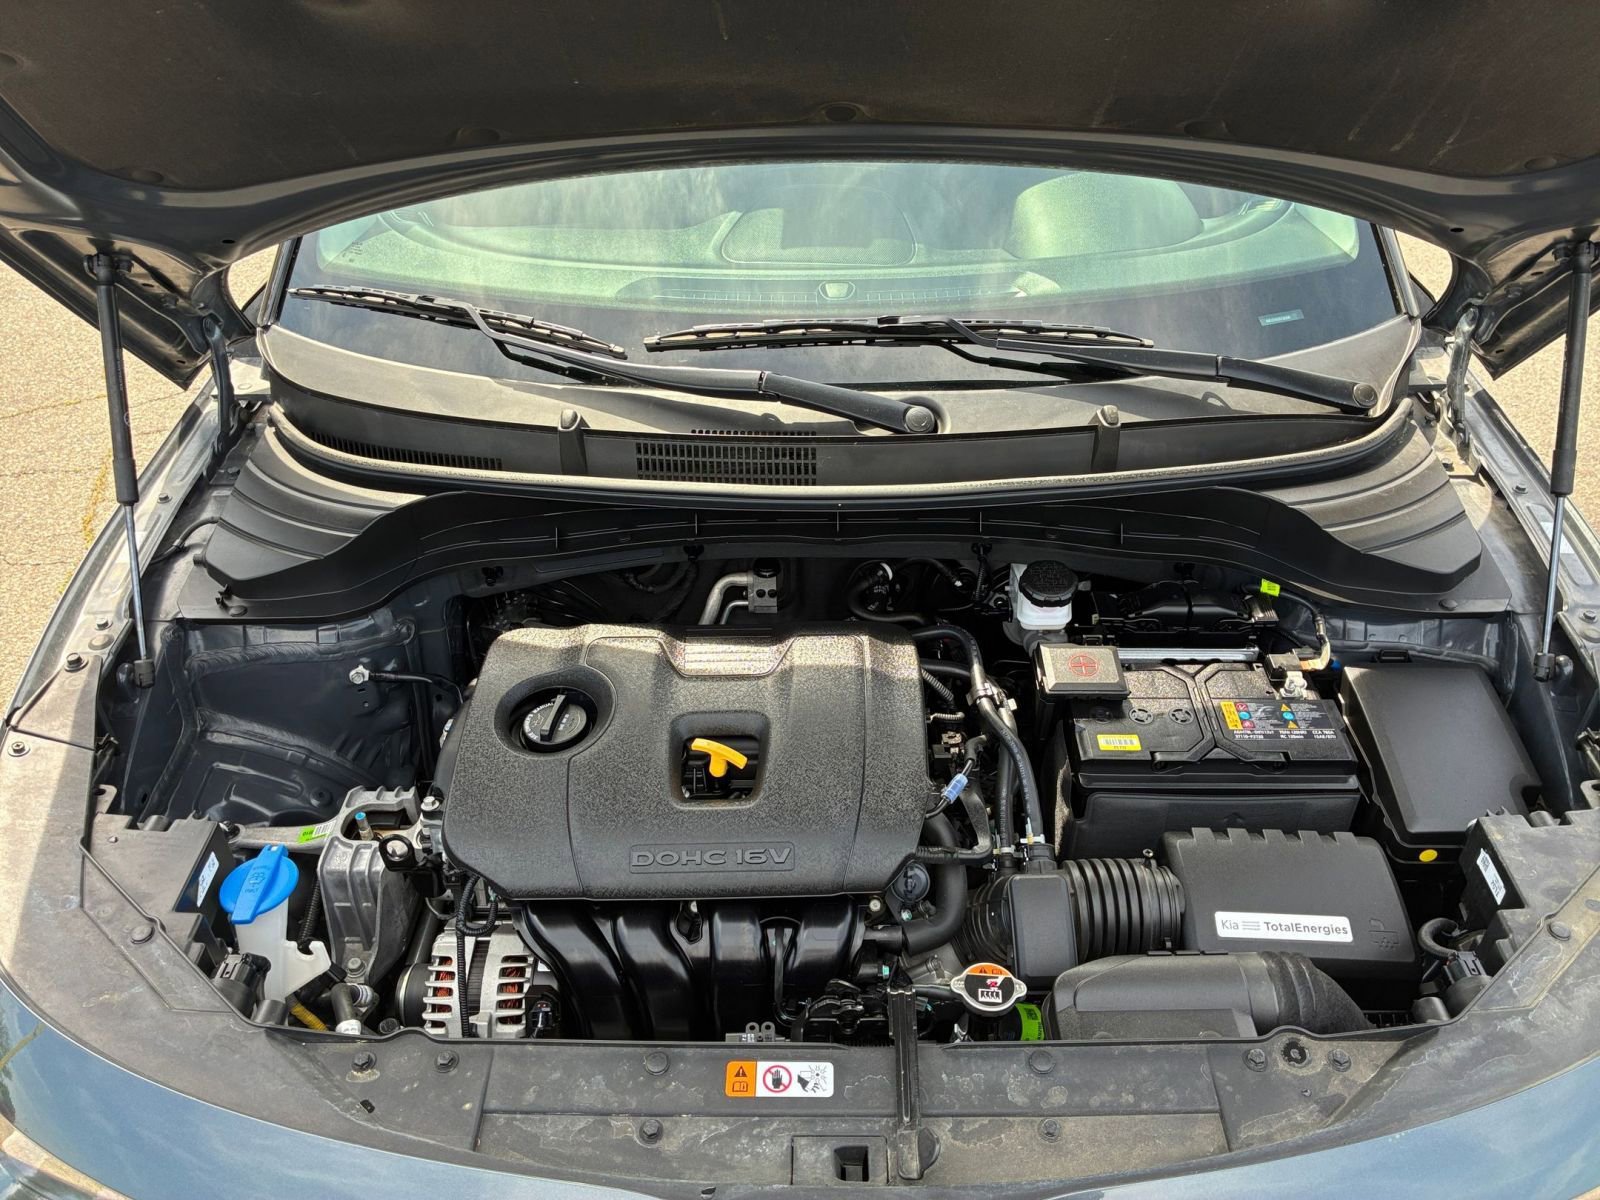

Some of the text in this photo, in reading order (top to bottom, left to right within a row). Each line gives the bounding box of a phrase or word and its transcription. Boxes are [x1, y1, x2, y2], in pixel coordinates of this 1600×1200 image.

[632, 848, 792, 867] DOHC 16V
[1221, 919, 1348, 936] Kia TotalEnergies
